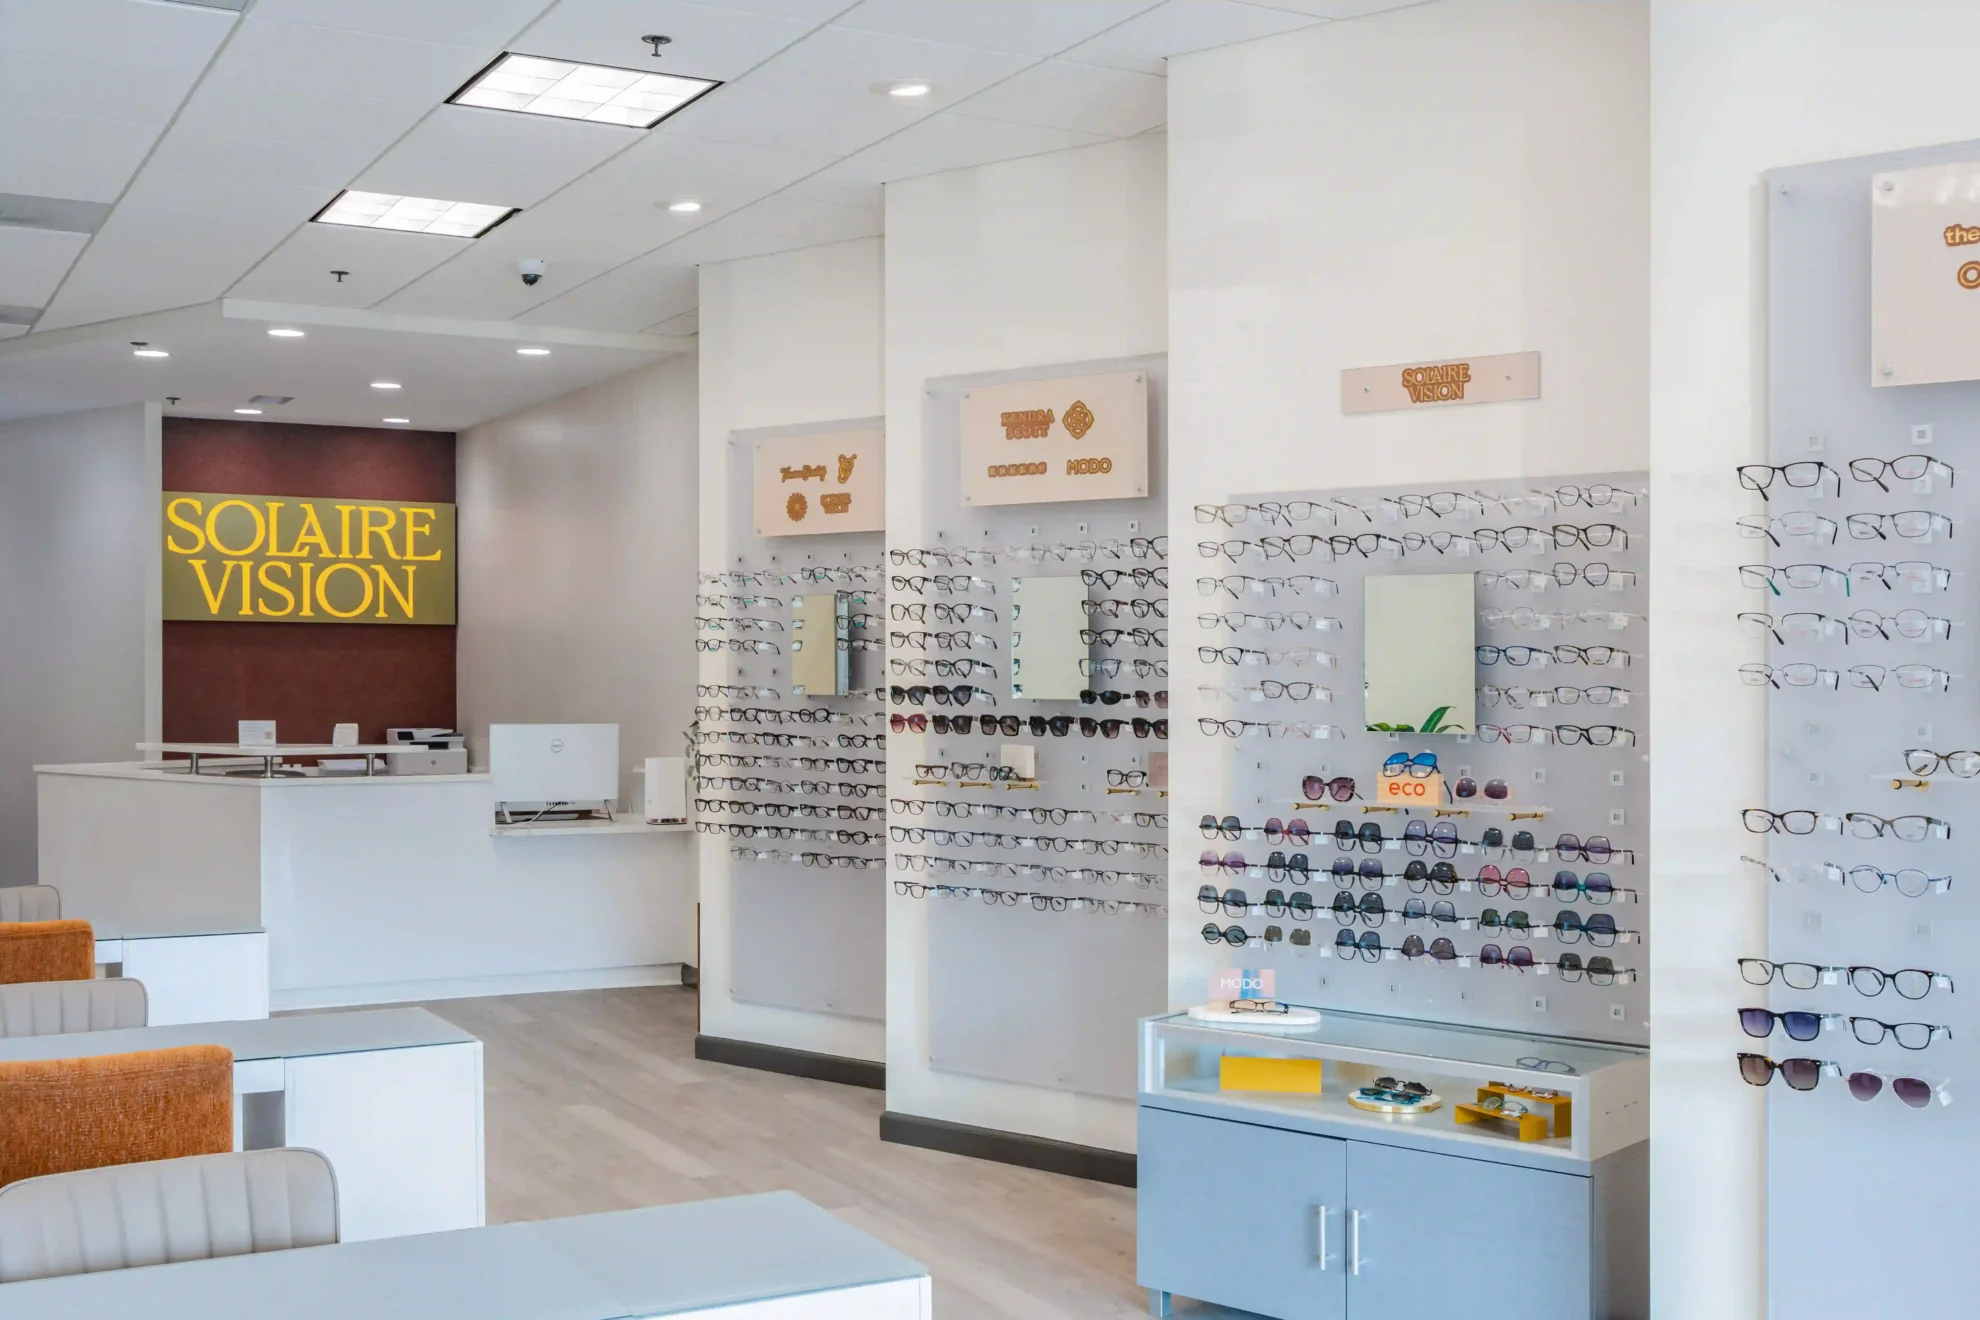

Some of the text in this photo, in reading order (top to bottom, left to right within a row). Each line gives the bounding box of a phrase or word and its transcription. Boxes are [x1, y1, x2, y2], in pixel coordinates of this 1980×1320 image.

[1944, 224, 1980, 247] the
[1402, 363, 1471, 388] SOLAIRE
[1408, 382, 1464, 403] VISION
[1001, 409, 1055, 427] KENDRA
[1006, 424, 1049, 440] SCOTT
[1066, 458, 1112, 475] MODO
[167, 498, 441, 561] SOLAIRE
[187, 559, 416, 618] VISION
[1388, 782, 1426, 796] eco
[1220, 978, 1264, 989] MODO
